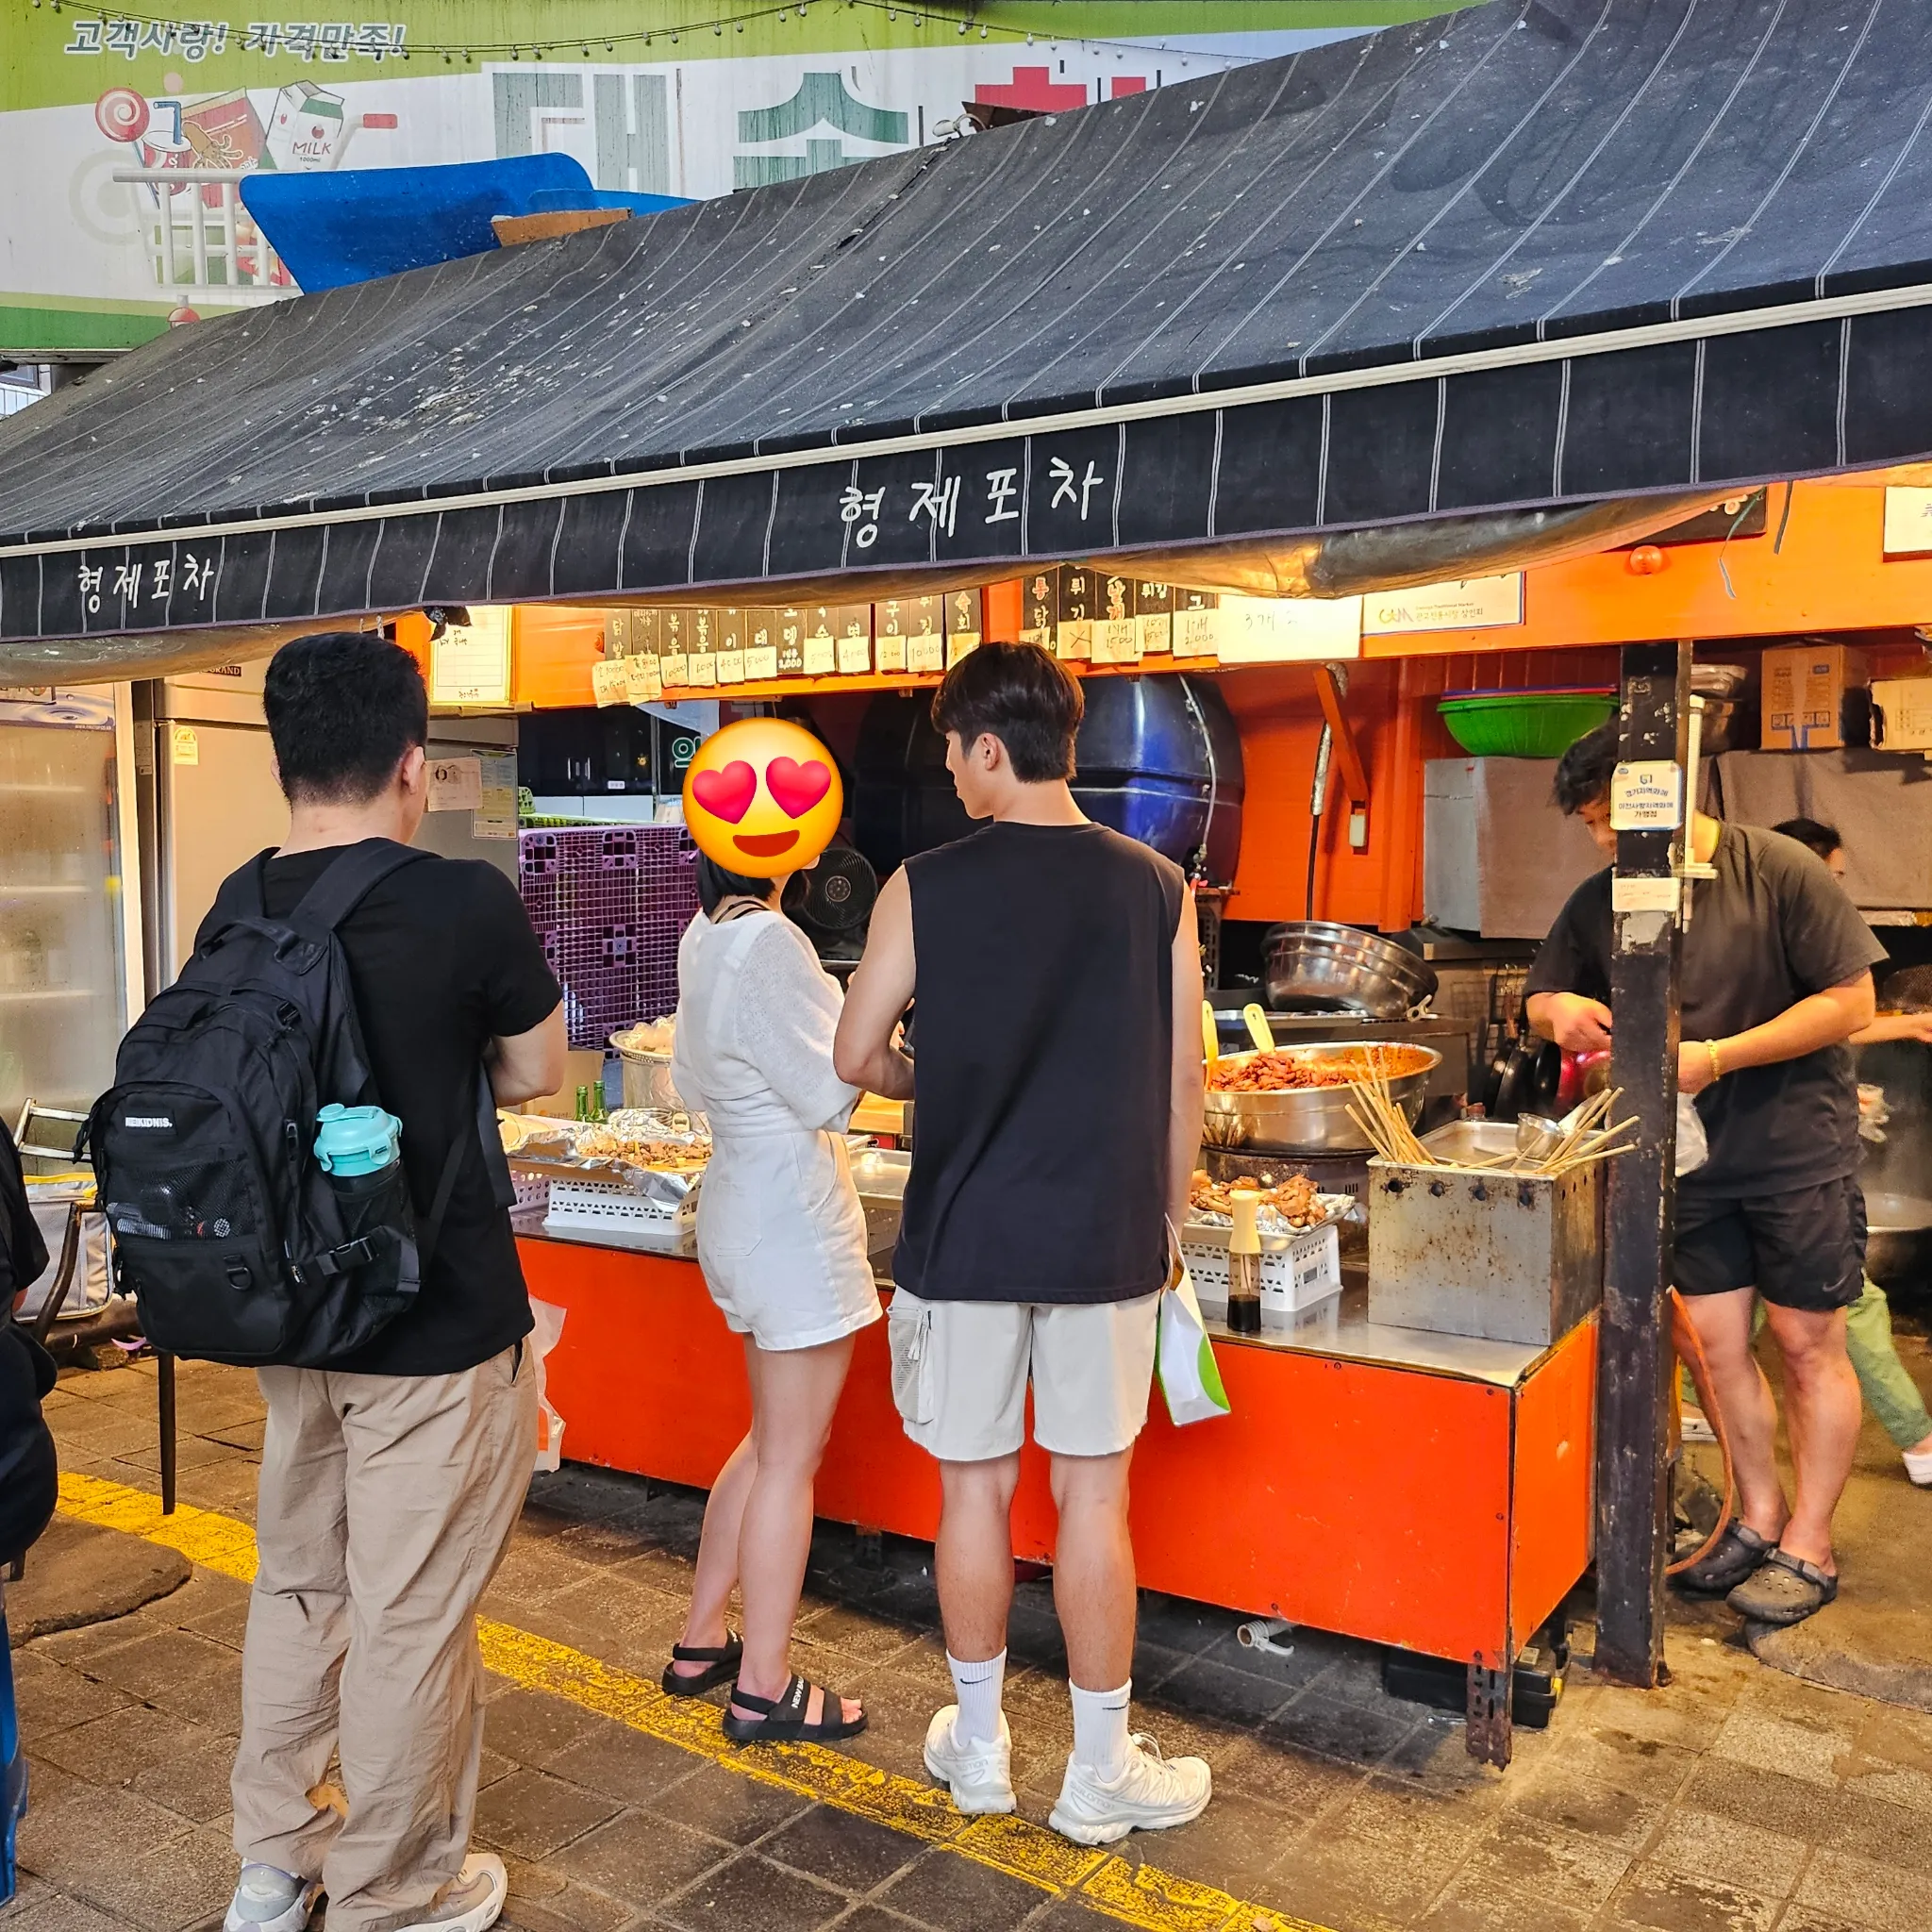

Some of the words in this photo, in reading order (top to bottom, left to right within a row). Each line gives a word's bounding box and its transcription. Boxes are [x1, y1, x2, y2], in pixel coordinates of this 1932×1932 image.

[65, 22, 228, 61] 고객사랑!
[245, 23, 407, 62] 가격만족!
[291, 142, 331, 155] MILK
[839, 457, 1104, 548] 형제포차
[77, 553, 214, 613] 형제포차
[1107, 576, 1125, 620] 날개
